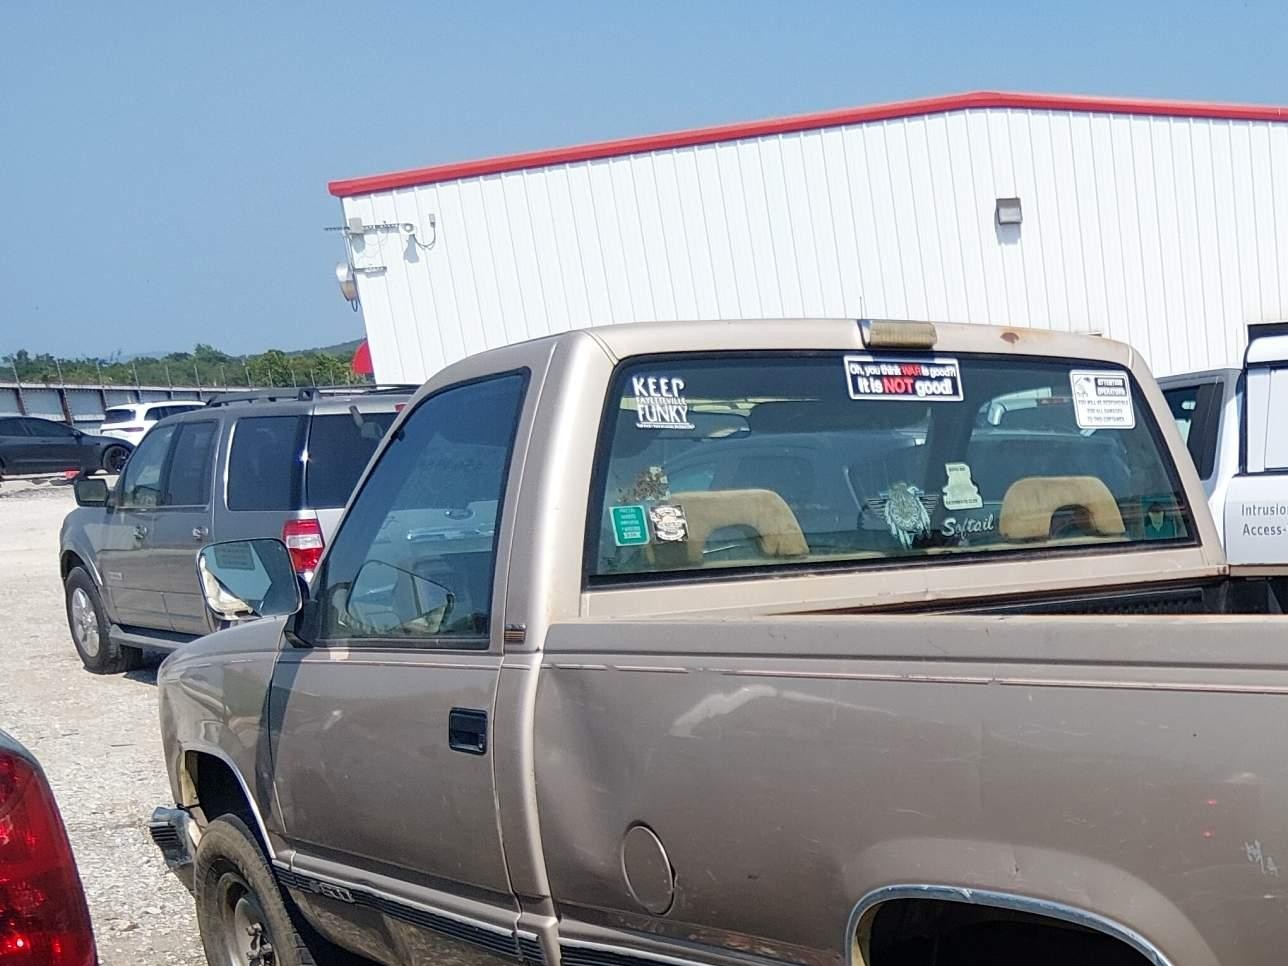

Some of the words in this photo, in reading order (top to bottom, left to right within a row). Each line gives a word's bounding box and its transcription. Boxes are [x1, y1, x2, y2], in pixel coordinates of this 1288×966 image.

[865, 366, 880, 377] you
[880, 364, 902, 376] think
[632, 376, 685, 397] KEEP
[857, 377, 870, 394] It
[870, 378, 883, 393] is
[883, 377, 914, 394] NOT
[915, 378, 953, 397] good!
[637, 404, 689, 422] FUNKY
[942, 513, 994, 539] Softail
